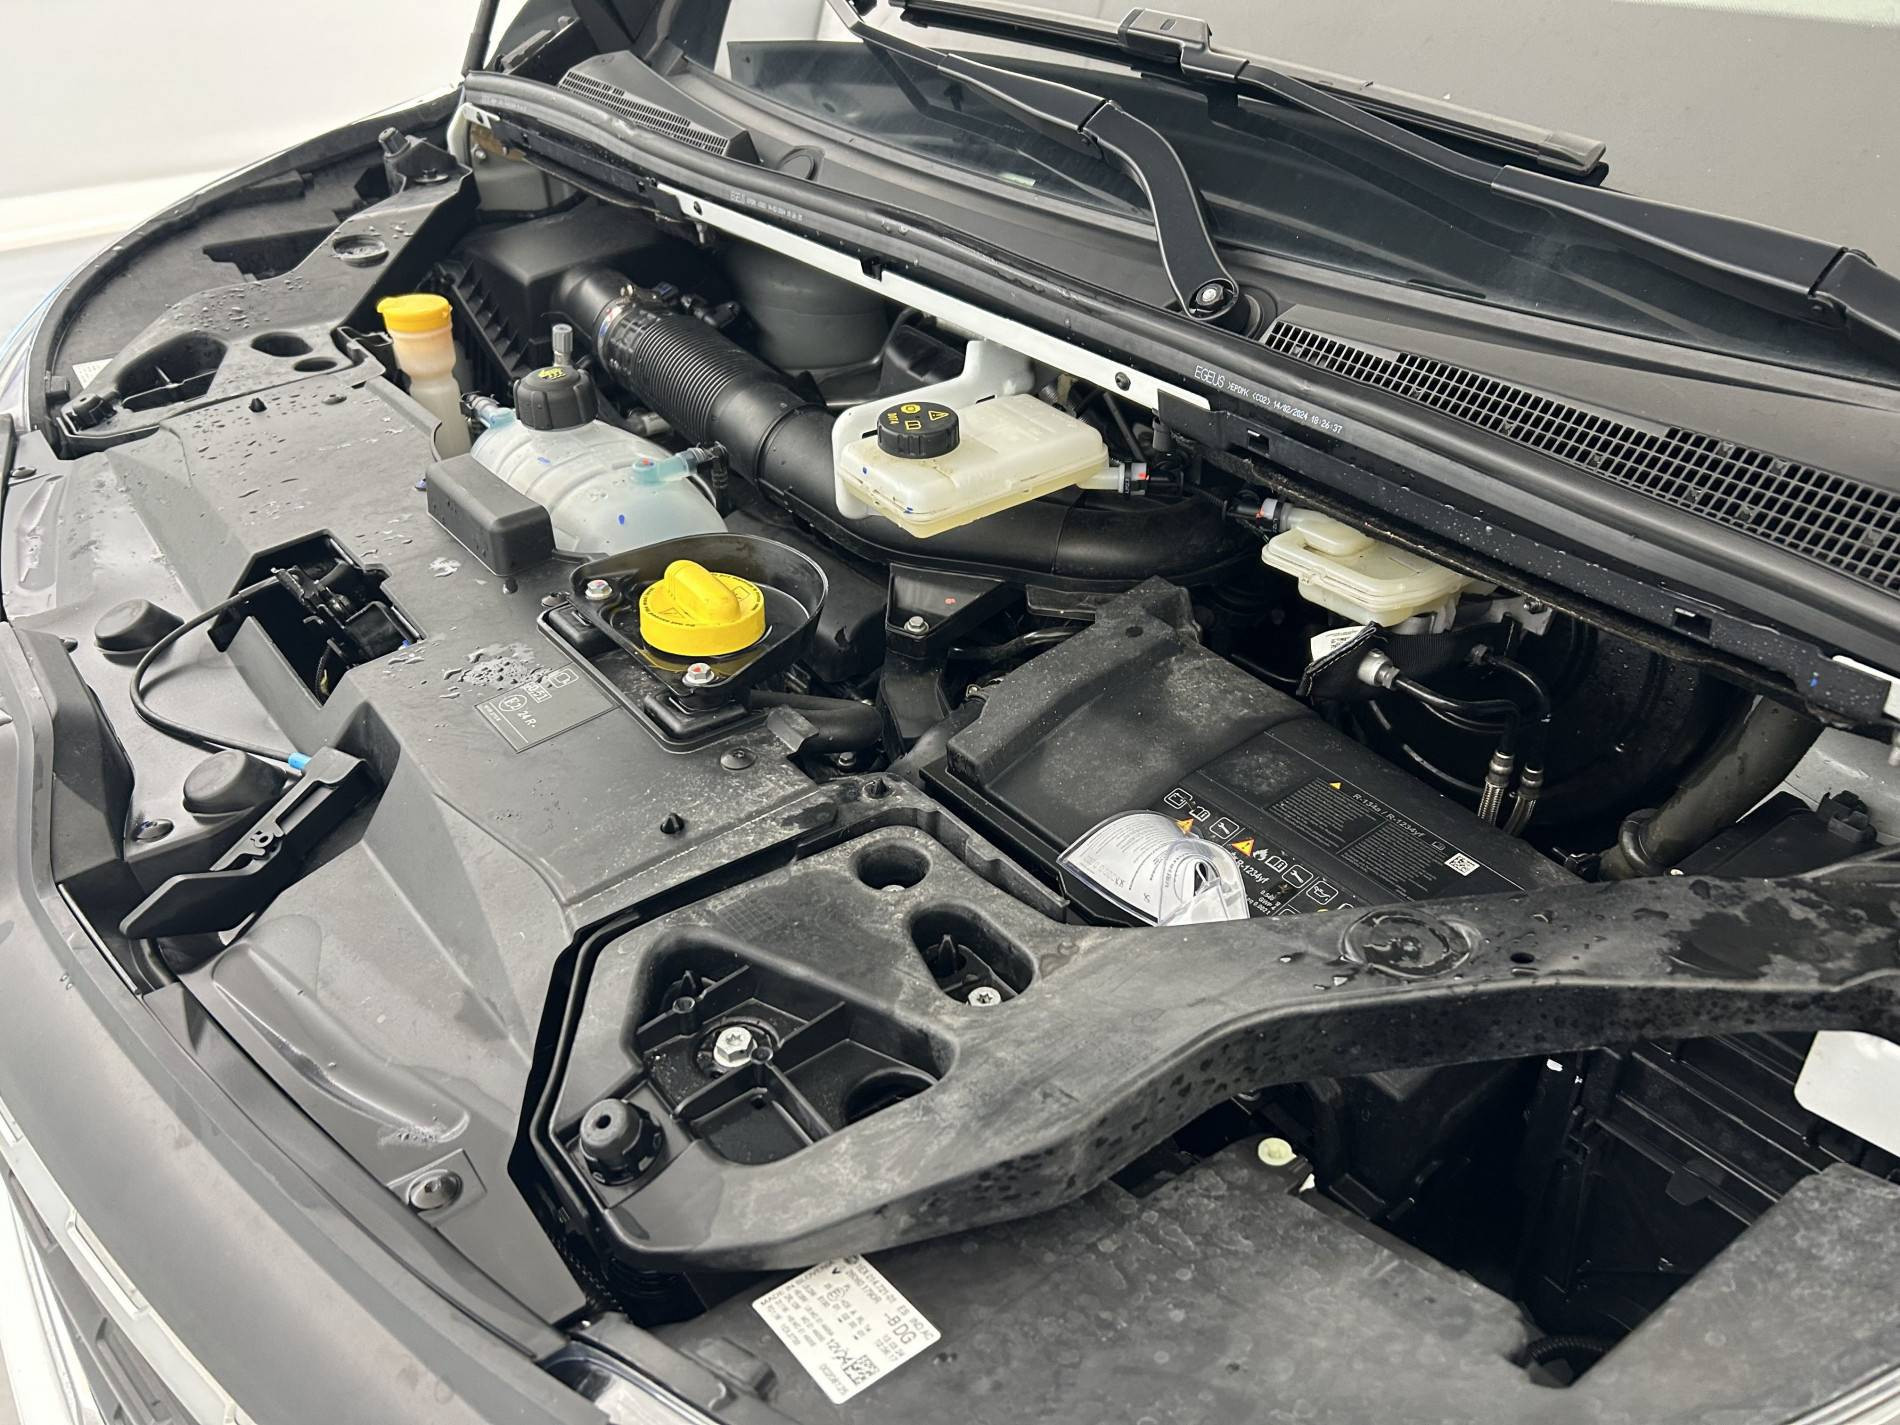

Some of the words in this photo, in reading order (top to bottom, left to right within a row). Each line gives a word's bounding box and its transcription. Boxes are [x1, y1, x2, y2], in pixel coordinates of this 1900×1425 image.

[1194, 364, 1226, 388] EGEUS
[1352, 793, 1381, 812] R-134a
[1386, 813, 1426, 838] R-1234yf
